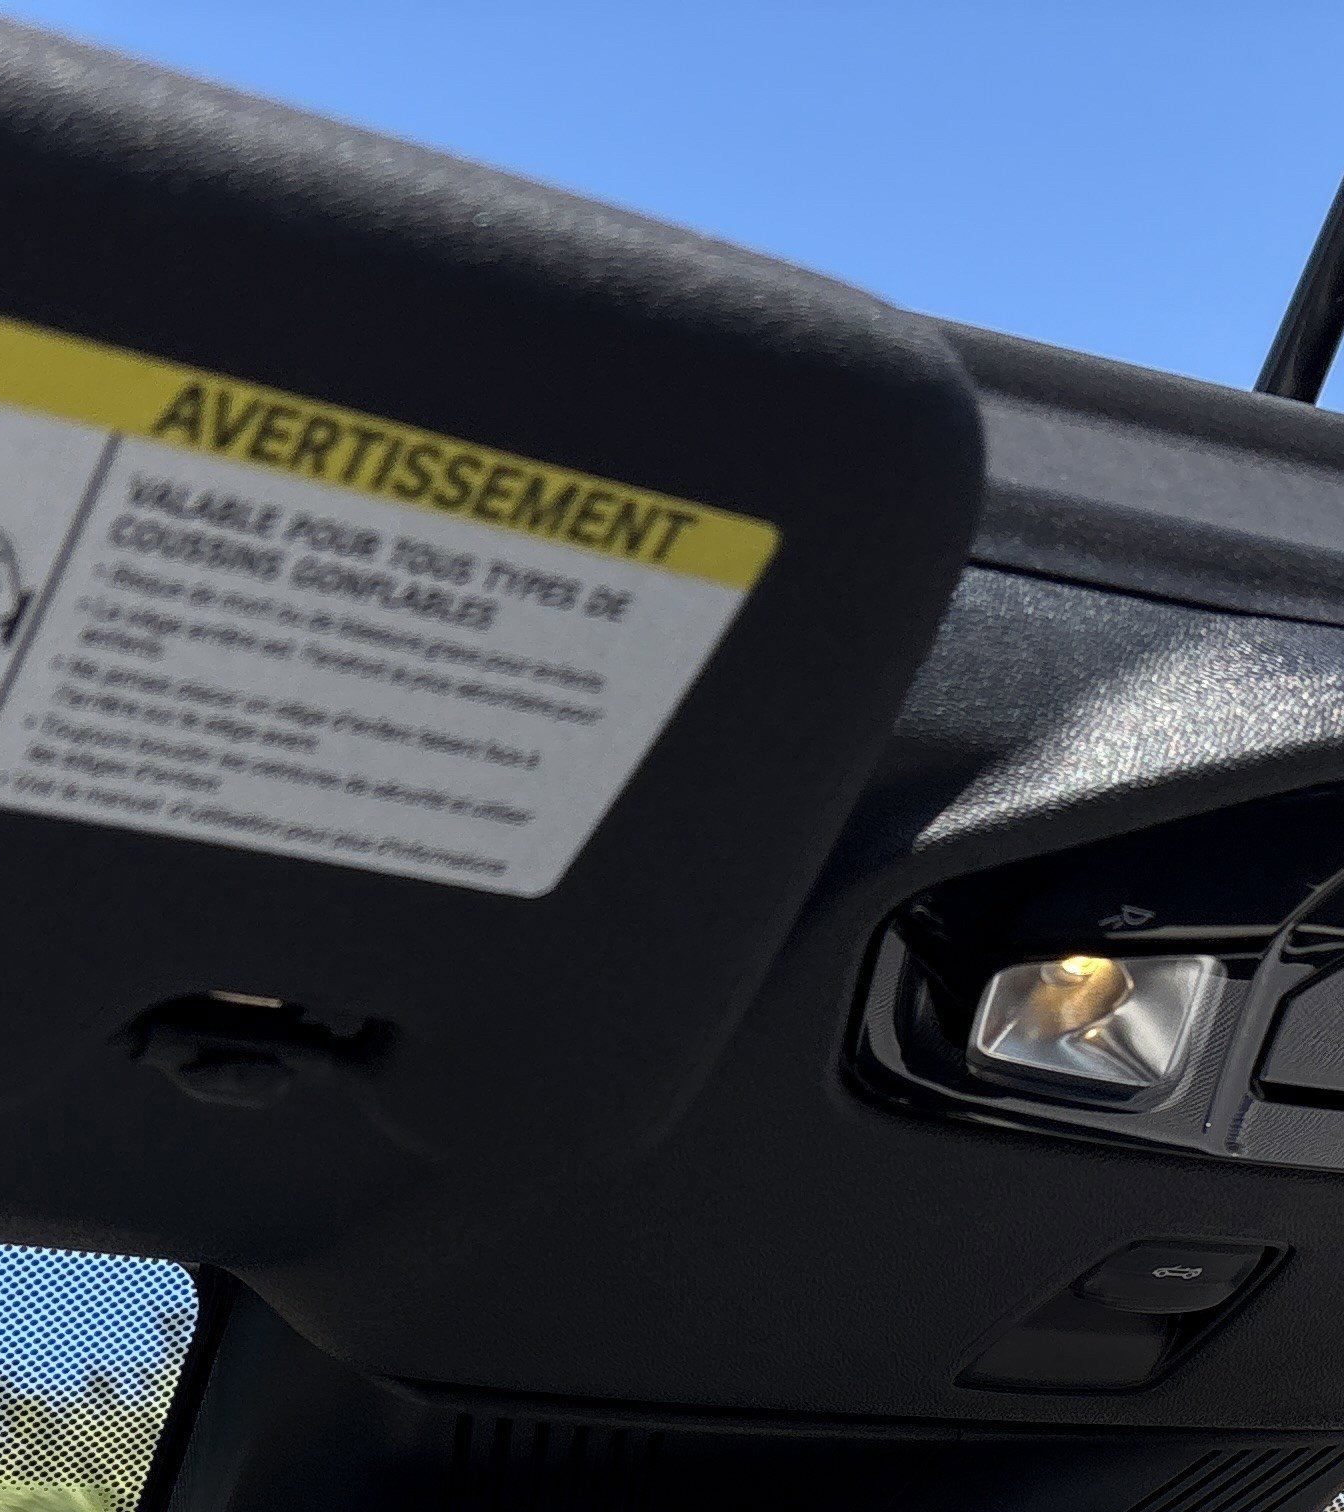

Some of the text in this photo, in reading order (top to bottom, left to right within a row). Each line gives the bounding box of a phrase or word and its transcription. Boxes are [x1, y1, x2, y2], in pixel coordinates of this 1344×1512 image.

[153, 380, 702, 564] AVERTISSEMENT
[106, 514, 502, 629] COUSSINS GONFLABLES
[124, 473, 638, 618] VALABLE POUR TOUS TYPES DE
